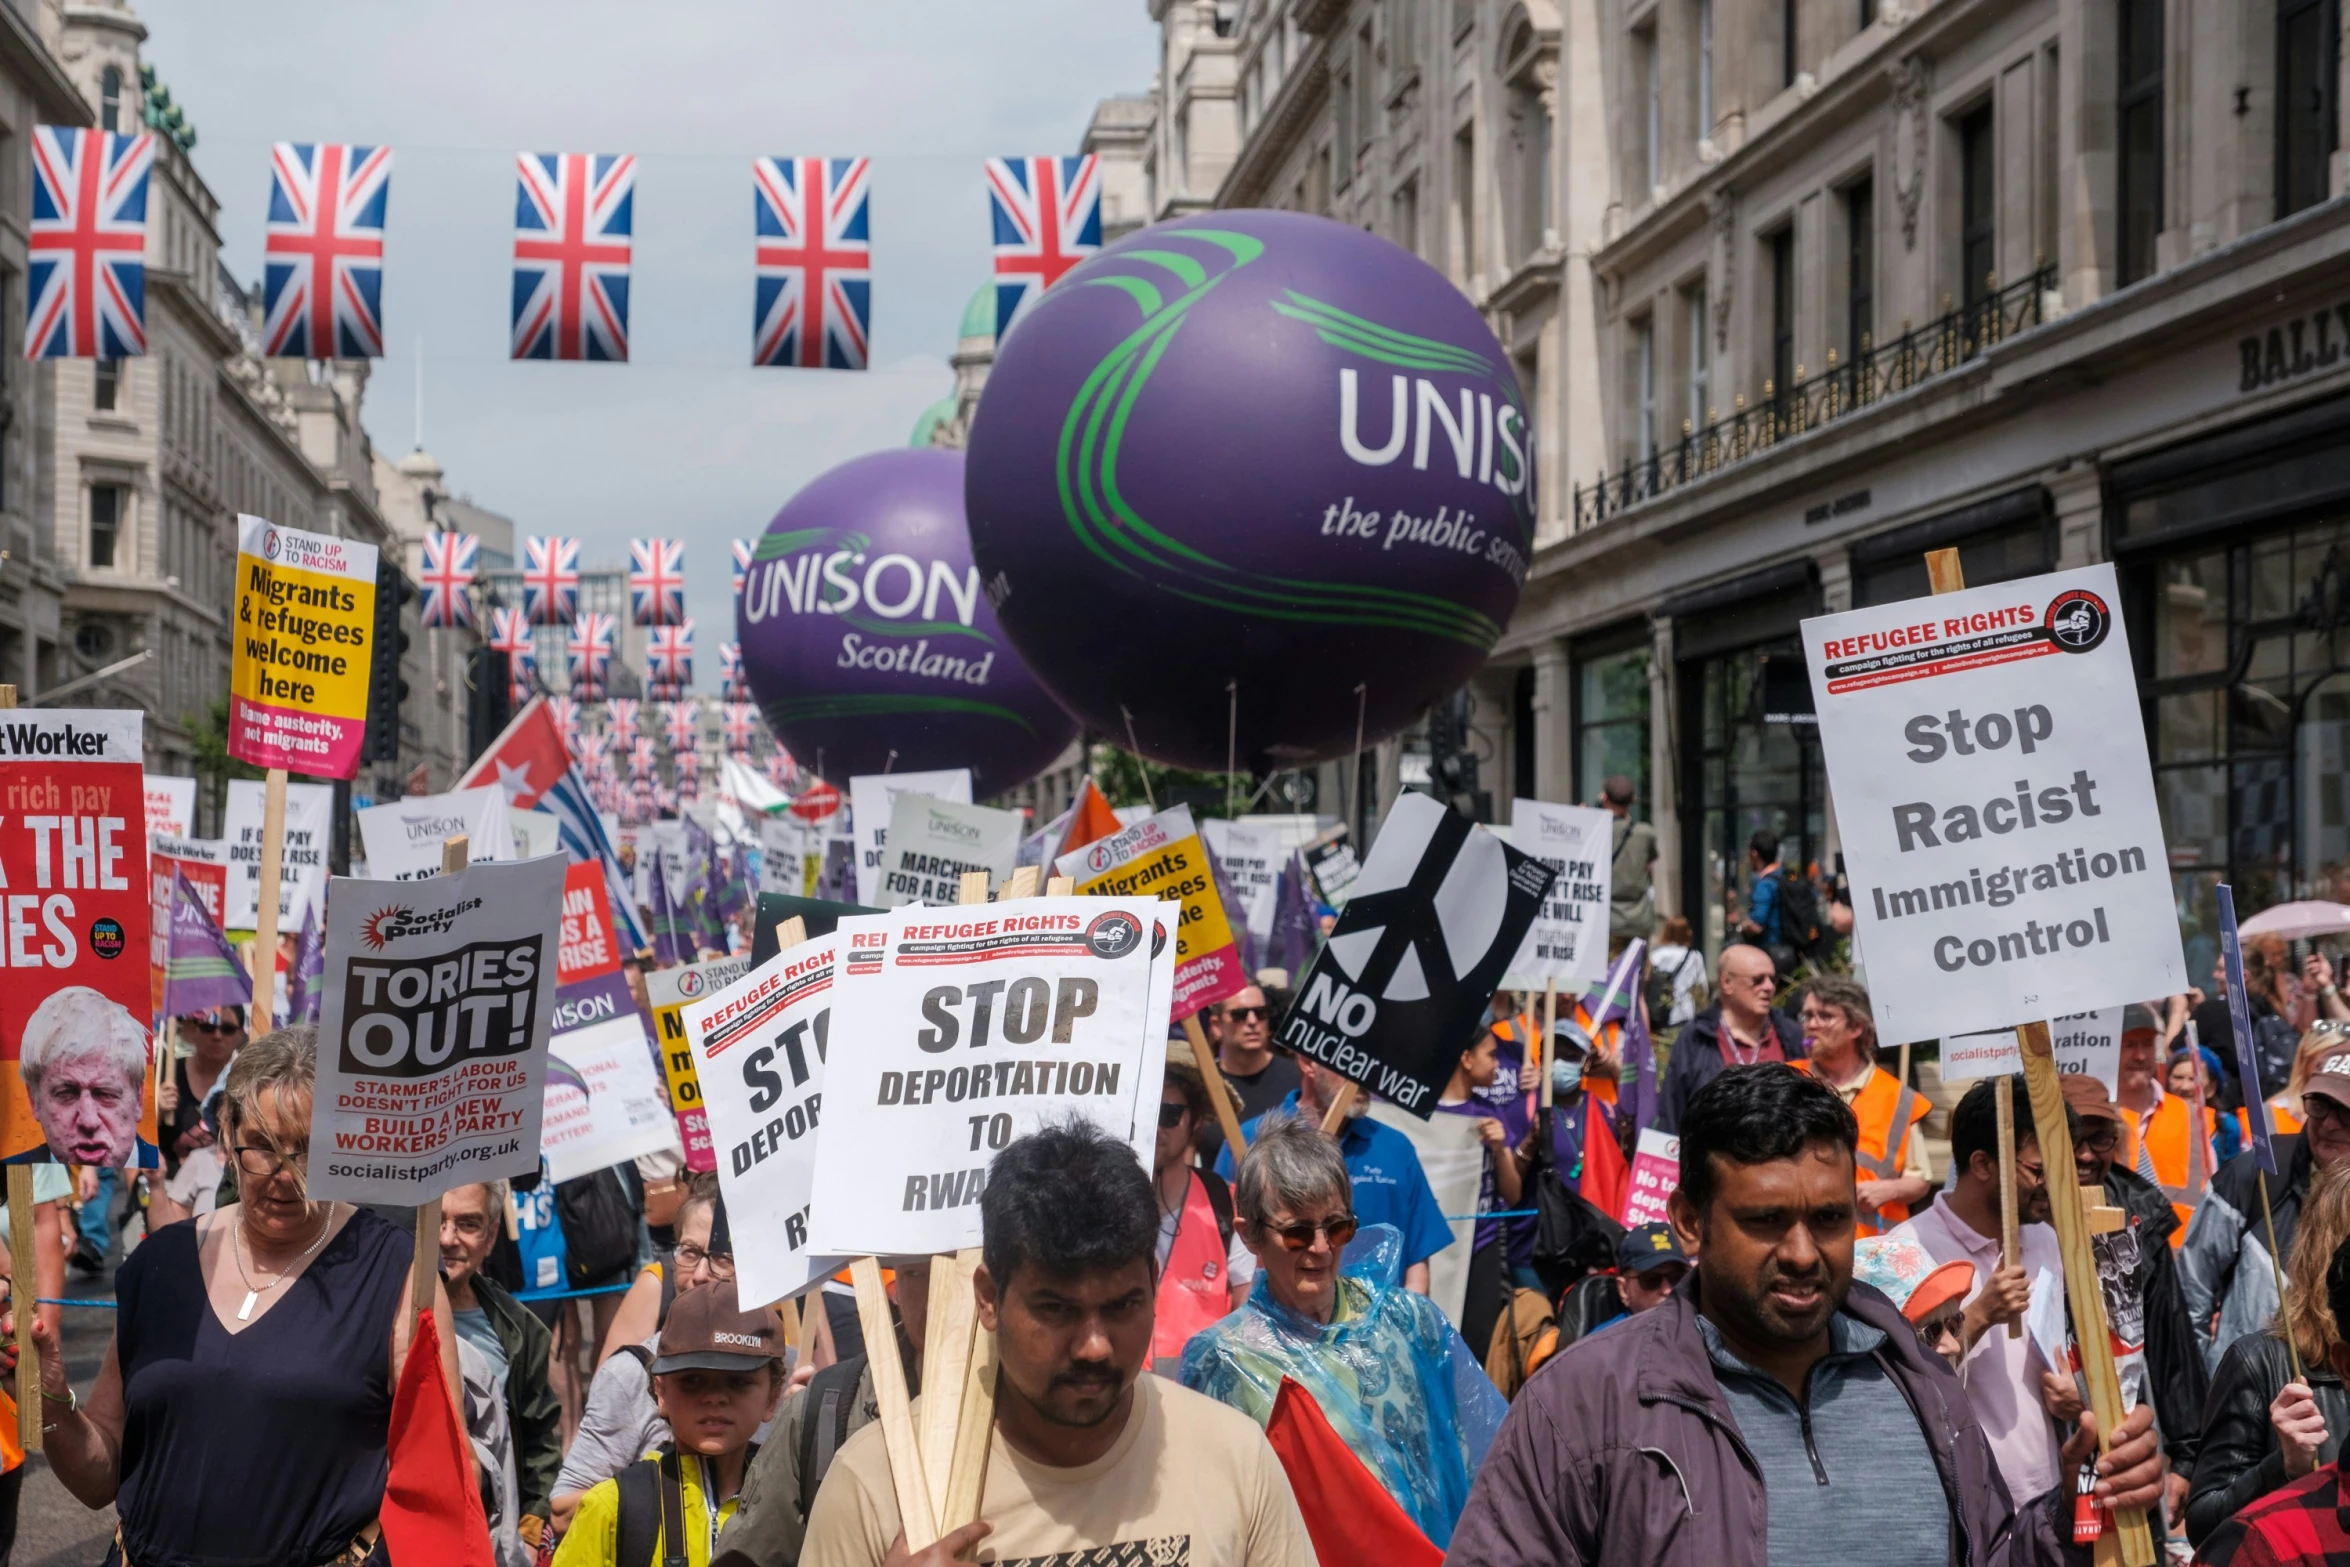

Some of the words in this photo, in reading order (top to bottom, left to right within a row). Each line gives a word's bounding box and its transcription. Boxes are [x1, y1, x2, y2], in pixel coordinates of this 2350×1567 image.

[1321, 496, 1380, 538] the
[1382, 505, 1486, 554] public
[285, 536, 321, 553] STAND
[324, 544, 342, 556] UP
[285, 550, 299, 563] TO
[302, 555, 347, 572] RACISM
[250, 564, 355, 612] Migrants
[745, 551, 980, 627] UNISON
[240, 595, 251, 623] &
[258, 607, 364, 646] refugees
[1823, 622, 1937, 660] REFUGEE
[1944, 604, 2035, 638] RIGHTS
[246, 638, 347, 676] welcome
[836, 633, 995, 686] Scotland
[1839, 660, 1881, 673] campaign
[1882, 653, 1916, 666] fighting
[1916, 651, 1929, 659] for
[1930, 647, 1945, 657] the
[1946, 643, 1971, 654] rights
[1972, 639, 1981, 649] of
[1982, 637, 1994, 647] all
[1995, 631, 2033, 645] refugees
[259, 669, 315, 704] here
[240, 701, 270, 726] Blame
[6, 723, 108, 756] Worker
[244, 726, 261, 743] not
[263, 729, 329, 754] migrants
[1904, 703, 2054, 764] Stop
[7, 776, 60, 810] rich
[71, 785, 111, 818] pay
[1892, 770, 2102, 853] Racist
[241, 827, 253, 842] IF
[287, 829, 312, 847] PAY
[406, 816, 465, 841] UNISON
[928, 819, 981, 840] UNISON
[1111, 830, 1142, 853] STAND
[1142, 822, 1158, 838] UP
[1539, 821, 1582, 838] UNISON
[24, 815, 128, 891] THE
[182, 845, 216, 860] Worker
[290, 849, 320, 866] RISE
[1116, 851, 1129, 863] TO
[1129, 832, 1168, 856] RACISM
[886, 872, 919, 894] FOR
[921, 879, 932, 898] A
[1568, 860, 1596, 881] PAY
[1872, 846, 2147, 921] Immigration
[1573, 882, 1605, 904] RISE
[394, 897, 483, 926] Socialist
[586, 913, 603, 940] A
[902, 919, 998, 940] REFUGEE
[1003, 914, 1081, 933] RIGHTS
[1553, 902, 1583, 923] WILL
[94, 924, 118, 933] STAND
[94, 932, 105, 941] UP
[106, 932, 116, 941] TO
[95, 940, 122, 949] RACISM
[384, 920, 454, 942] Party
[910, 944, 946, 952] campaign
[947, 943, 975, 951] fighting
[975, 941, 986, 949] for
[986, 939, 998, 947] the
[999, 937, 1020, 946] rights
[1040, 934, 1074, 943] refugees
[1536, 928, 1577, 943] TOGETHER
[1933, 906, 2111, 973] Control
[557, 938, 609, 973] RISE
[1536, 945, 1550, 960] WE
[1552, 946, 1576, 962] RISE
[352, 945, 536, 1008] TORIES
[705, 963, 740, 980] STAND
[708, 981, 722, 991] TO
[1172, 972, 1219, 1003] igrants
[700, 973, 781, 1034] REFUGEE
[784, 948, 836, 981] RIGH
[713, 1018, 743, 1040] campaign
[743, 1002, 767, 1021] fighting
[766, 996, 775, 1005] for
[775, 989, 787, 999] the
[786, 979, 807, 992] rights
[807, 974, 815, 982] of
[815, 970, 825, 979] all
[1300, 971, 1376, 1038] NO
[348, 989, 531, 1068] OUT!
[917, 976, 1099, 1053] STOP
[2054, 1033, 2111, 1049] ration
[354, 1074, 450, 1097] STARMER'S
[453, 1060, 518, 1083] LABOUR
[1285, 1016, 1380, 1084] nuclear
[1378, 1060, 1431, 1109] war
[338, 1094, 420, 1112] DOESN'T
[424, 1083, 463, 1109] FIGHT
[467, 1077, 501, 1092] FOR
[506, 1071, 527, 1087] US
[877, 1060, 1121, 1106] DEPORTATION
[335, 1123, 452, 1153] WORKERS'
[455, 1109, 524, 1136] PARTY
[365, 1117, 435, 1137] BUILD
[439, 1111, 450, 1128] A
[454, 1097, 503, 1121] NEW
[968, 1112, 1013, 1152] TO
[731, 1092, 822, 1179] DEPOR
[328, 1138, 520, 1183] socialistparty.org.uk
[902, 1168, 986, 1212] RWA
[1635, 1169, 1658, 1188] No
[714, 1332, 761, 1349] BROOKLYN
